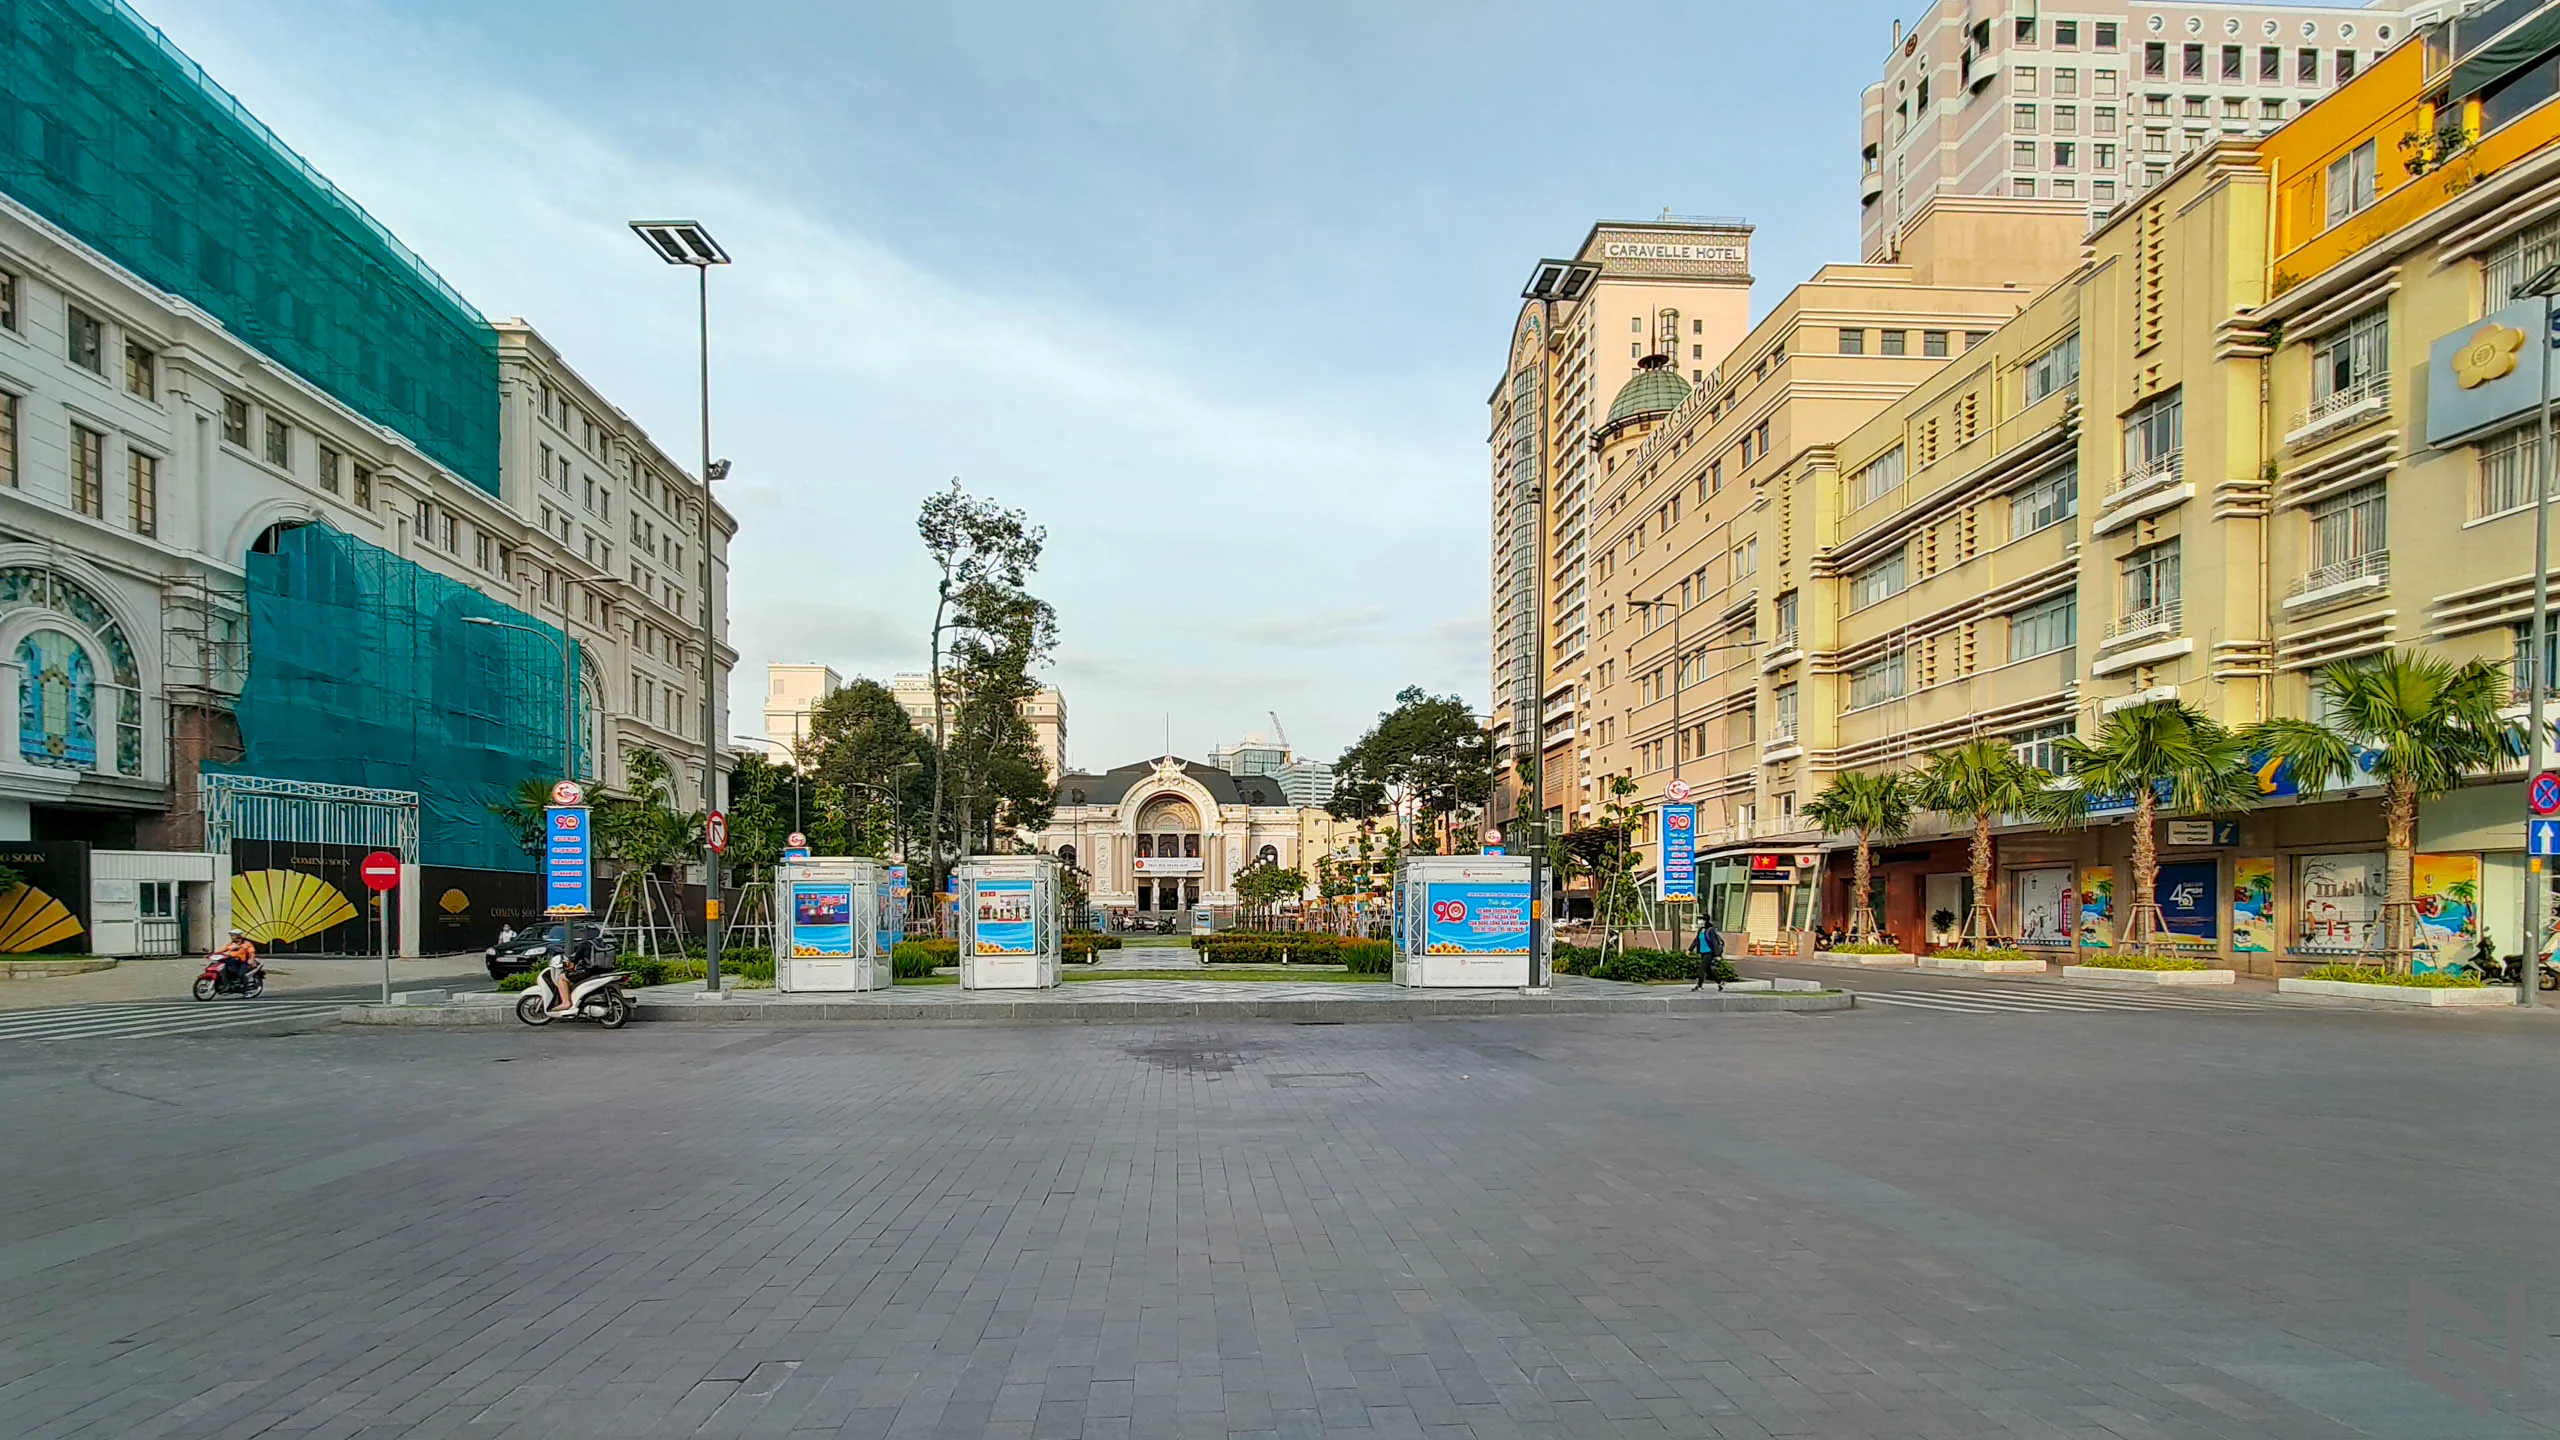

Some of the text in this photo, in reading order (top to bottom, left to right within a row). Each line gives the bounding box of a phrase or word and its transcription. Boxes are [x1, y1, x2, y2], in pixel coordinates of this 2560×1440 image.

[1609, 244, 1741, 260] CARAVELLE HOTEL
[1667, 814, 1691, 831] 90
[1432, 899, 1467, 924] 90
